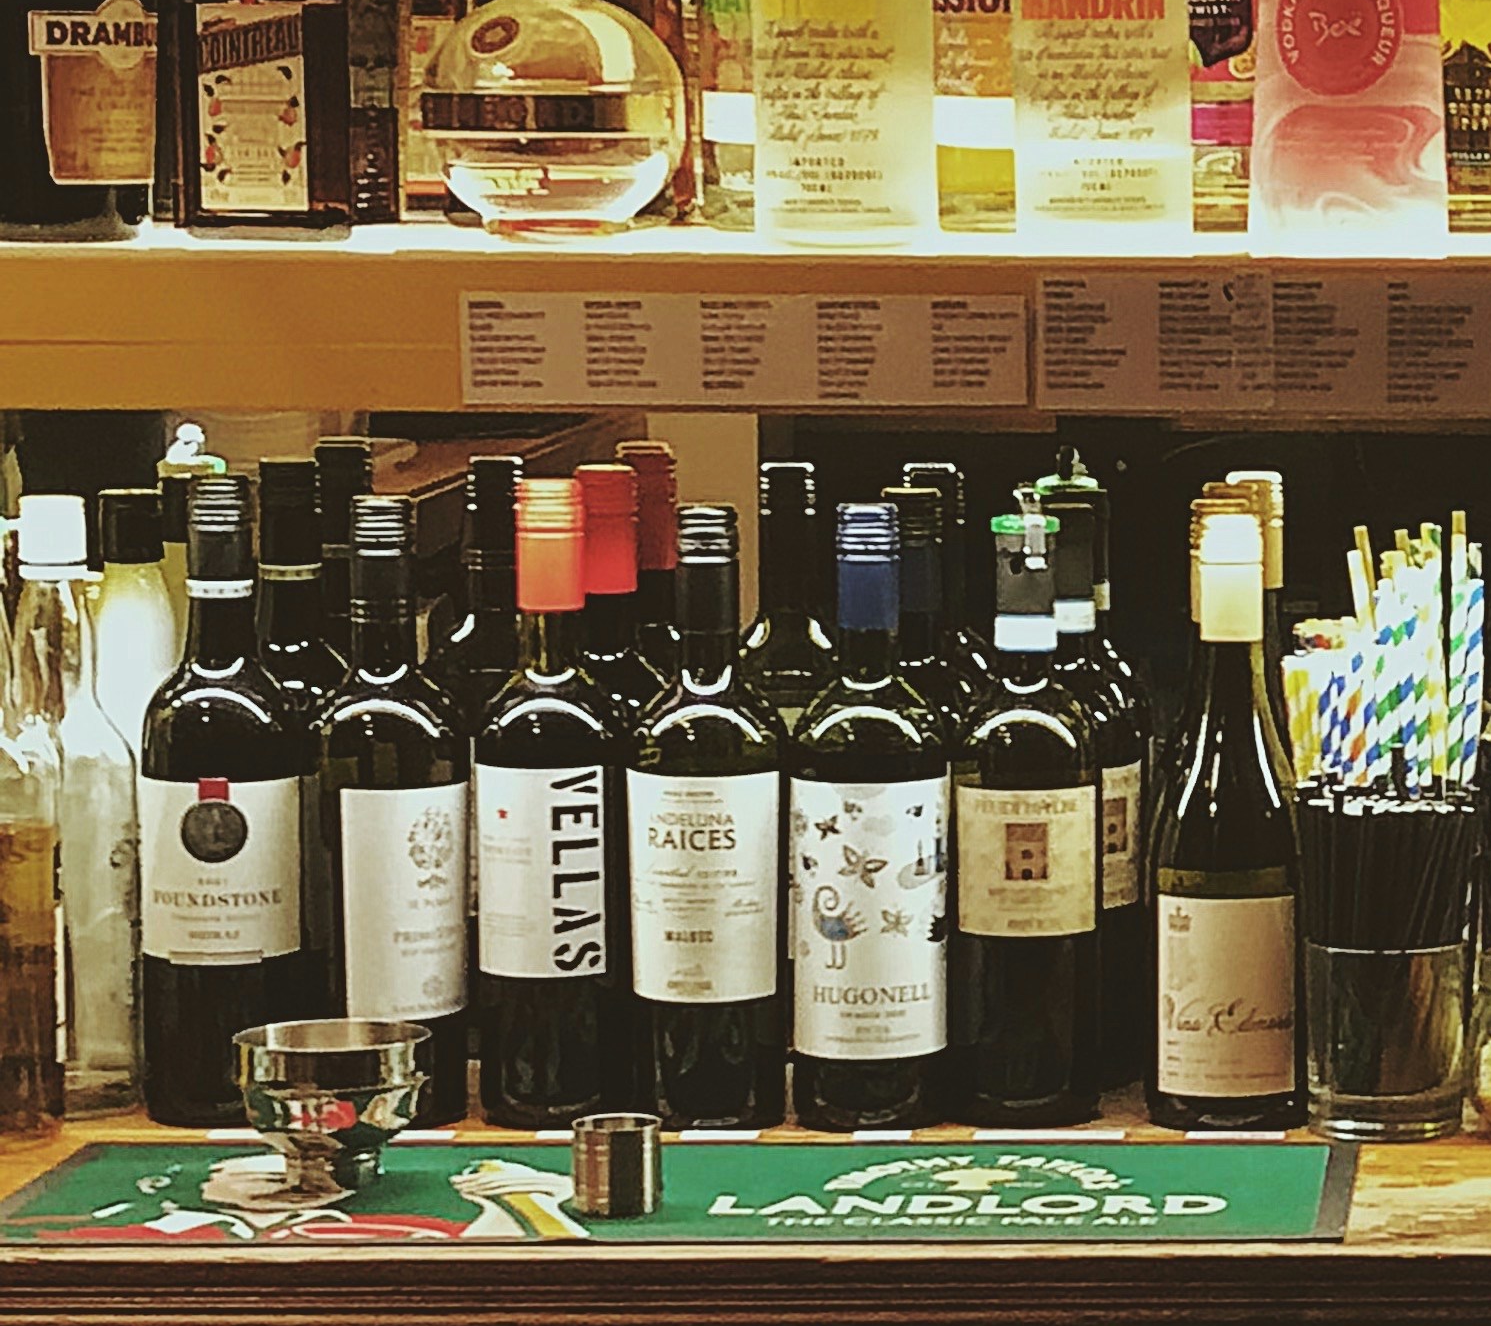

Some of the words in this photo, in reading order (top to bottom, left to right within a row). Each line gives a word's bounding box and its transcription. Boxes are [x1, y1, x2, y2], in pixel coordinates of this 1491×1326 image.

[201, 15, 301, 69] COINTREAU
[648, 827, 737, 852] RAICES
[549, 769, 608, 974] VELLAS
[813, 983, 932, 1006] HUGONELL
[707, 1194, 1229, 1216] LANDLORD
[767, 1216, 838, 1226] THE
[843, 1216, 993, 1226] CLASSIC
[999, 1216, 1087, 1226] PALE
[1091, 1215, 1160, 1226] ALE
